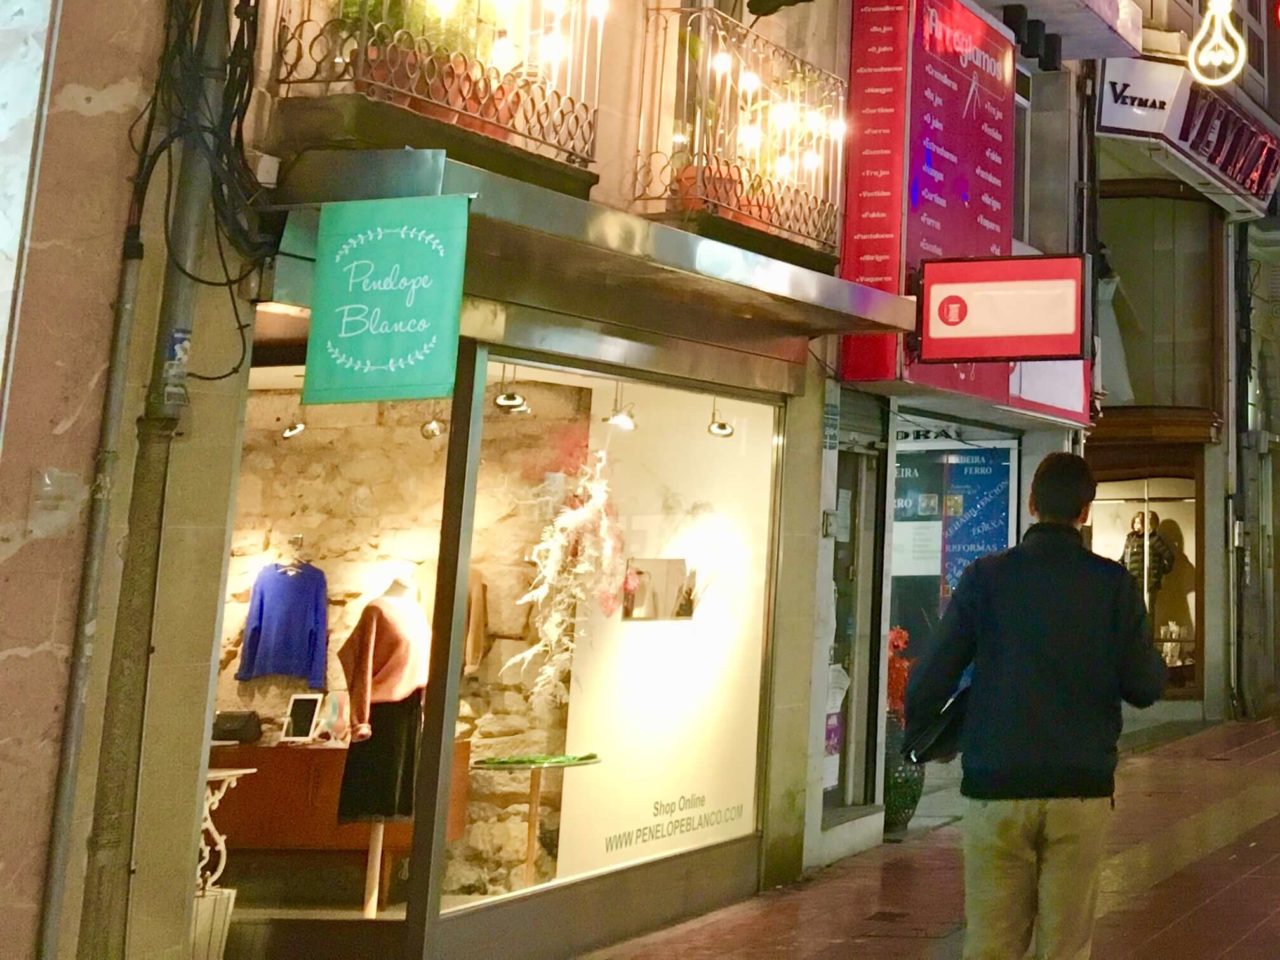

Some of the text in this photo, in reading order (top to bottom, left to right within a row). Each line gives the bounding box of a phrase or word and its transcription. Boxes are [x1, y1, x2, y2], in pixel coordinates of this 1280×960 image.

[1109, 81, 1167, 110] VEYMAR
[343, 260, 433, 307] Penelope
[335, 304, 430, 338] Blanco
[653, 793, 706, 818] Shop Online
